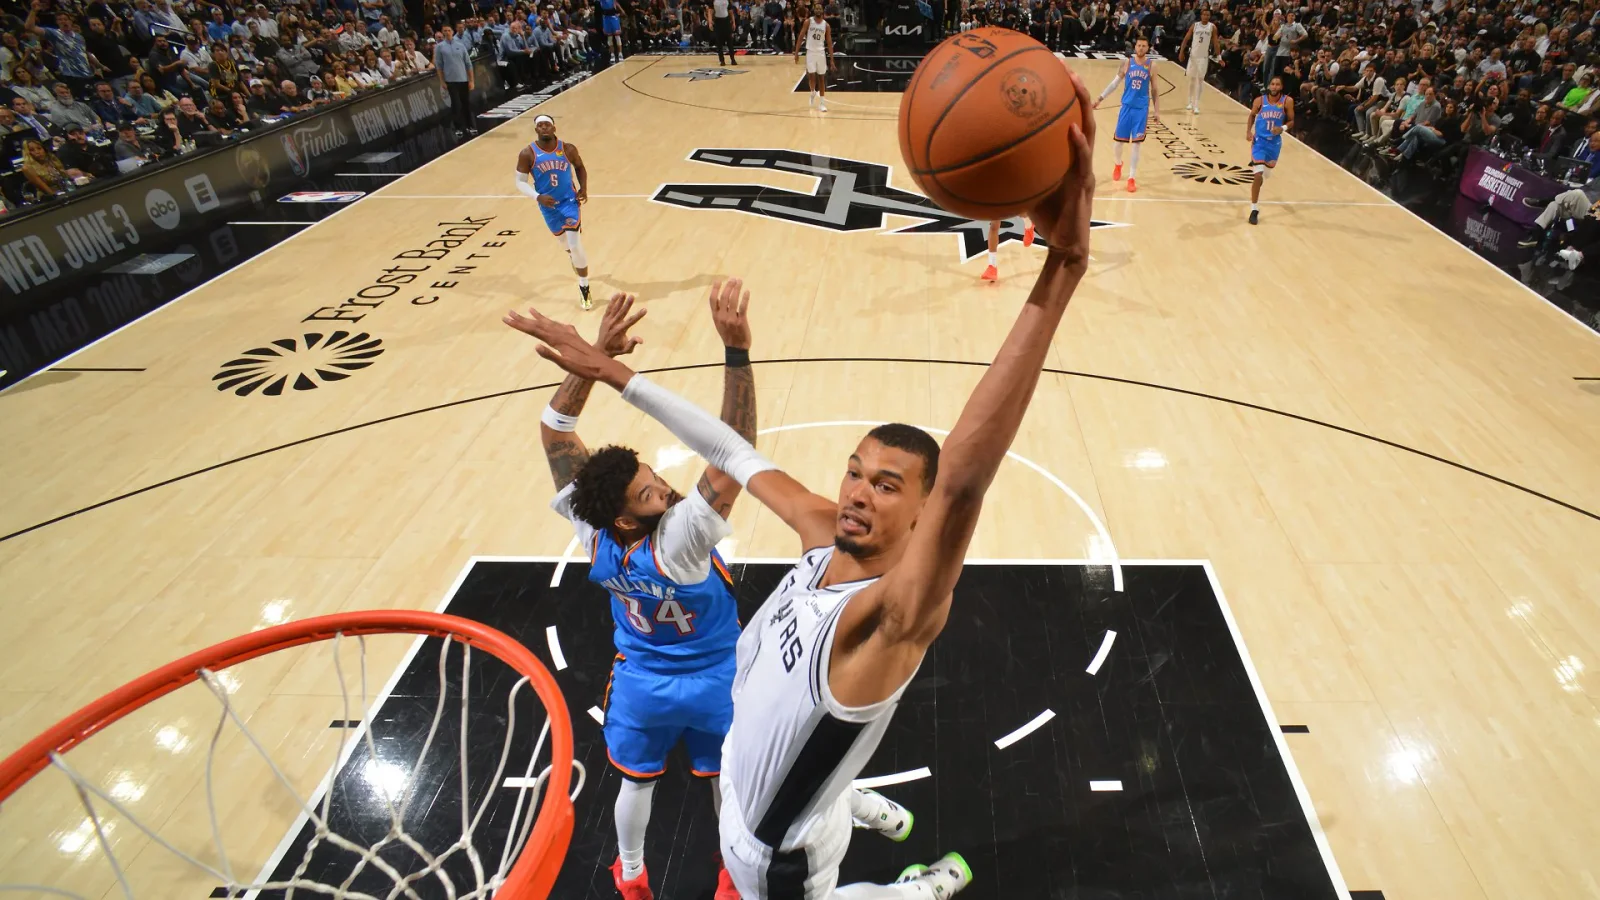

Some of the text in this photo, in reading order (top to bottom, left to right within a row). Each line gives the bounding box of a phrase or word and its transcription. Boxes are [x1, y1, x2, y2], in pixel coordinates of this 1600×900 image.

[812, 33, 821, 41] 40
[885, 25, 922, 35] KIA
[1131, 80, 1142, 90] 55
[294, 118, 348, 177] Finals
[352, 106, 388, 144] BEGIN
[384, 98, 408, 132] WED
[407, 89, 433, 123] JUNE
[427, 87, 438, 114] 3
[537, 160, 568, 173] THUNDER
[550, 173, 558, 187] 5
[1478, 173, 1518, 202] BASKETBALL
[0, 235, 60, 294] WED
[56, 210, 125, 269] JUNE
[112, 204, 140, 244] 3
[301, 215, 498, 324] Frost Bank
[411, 229, 521, 306] CENTER
